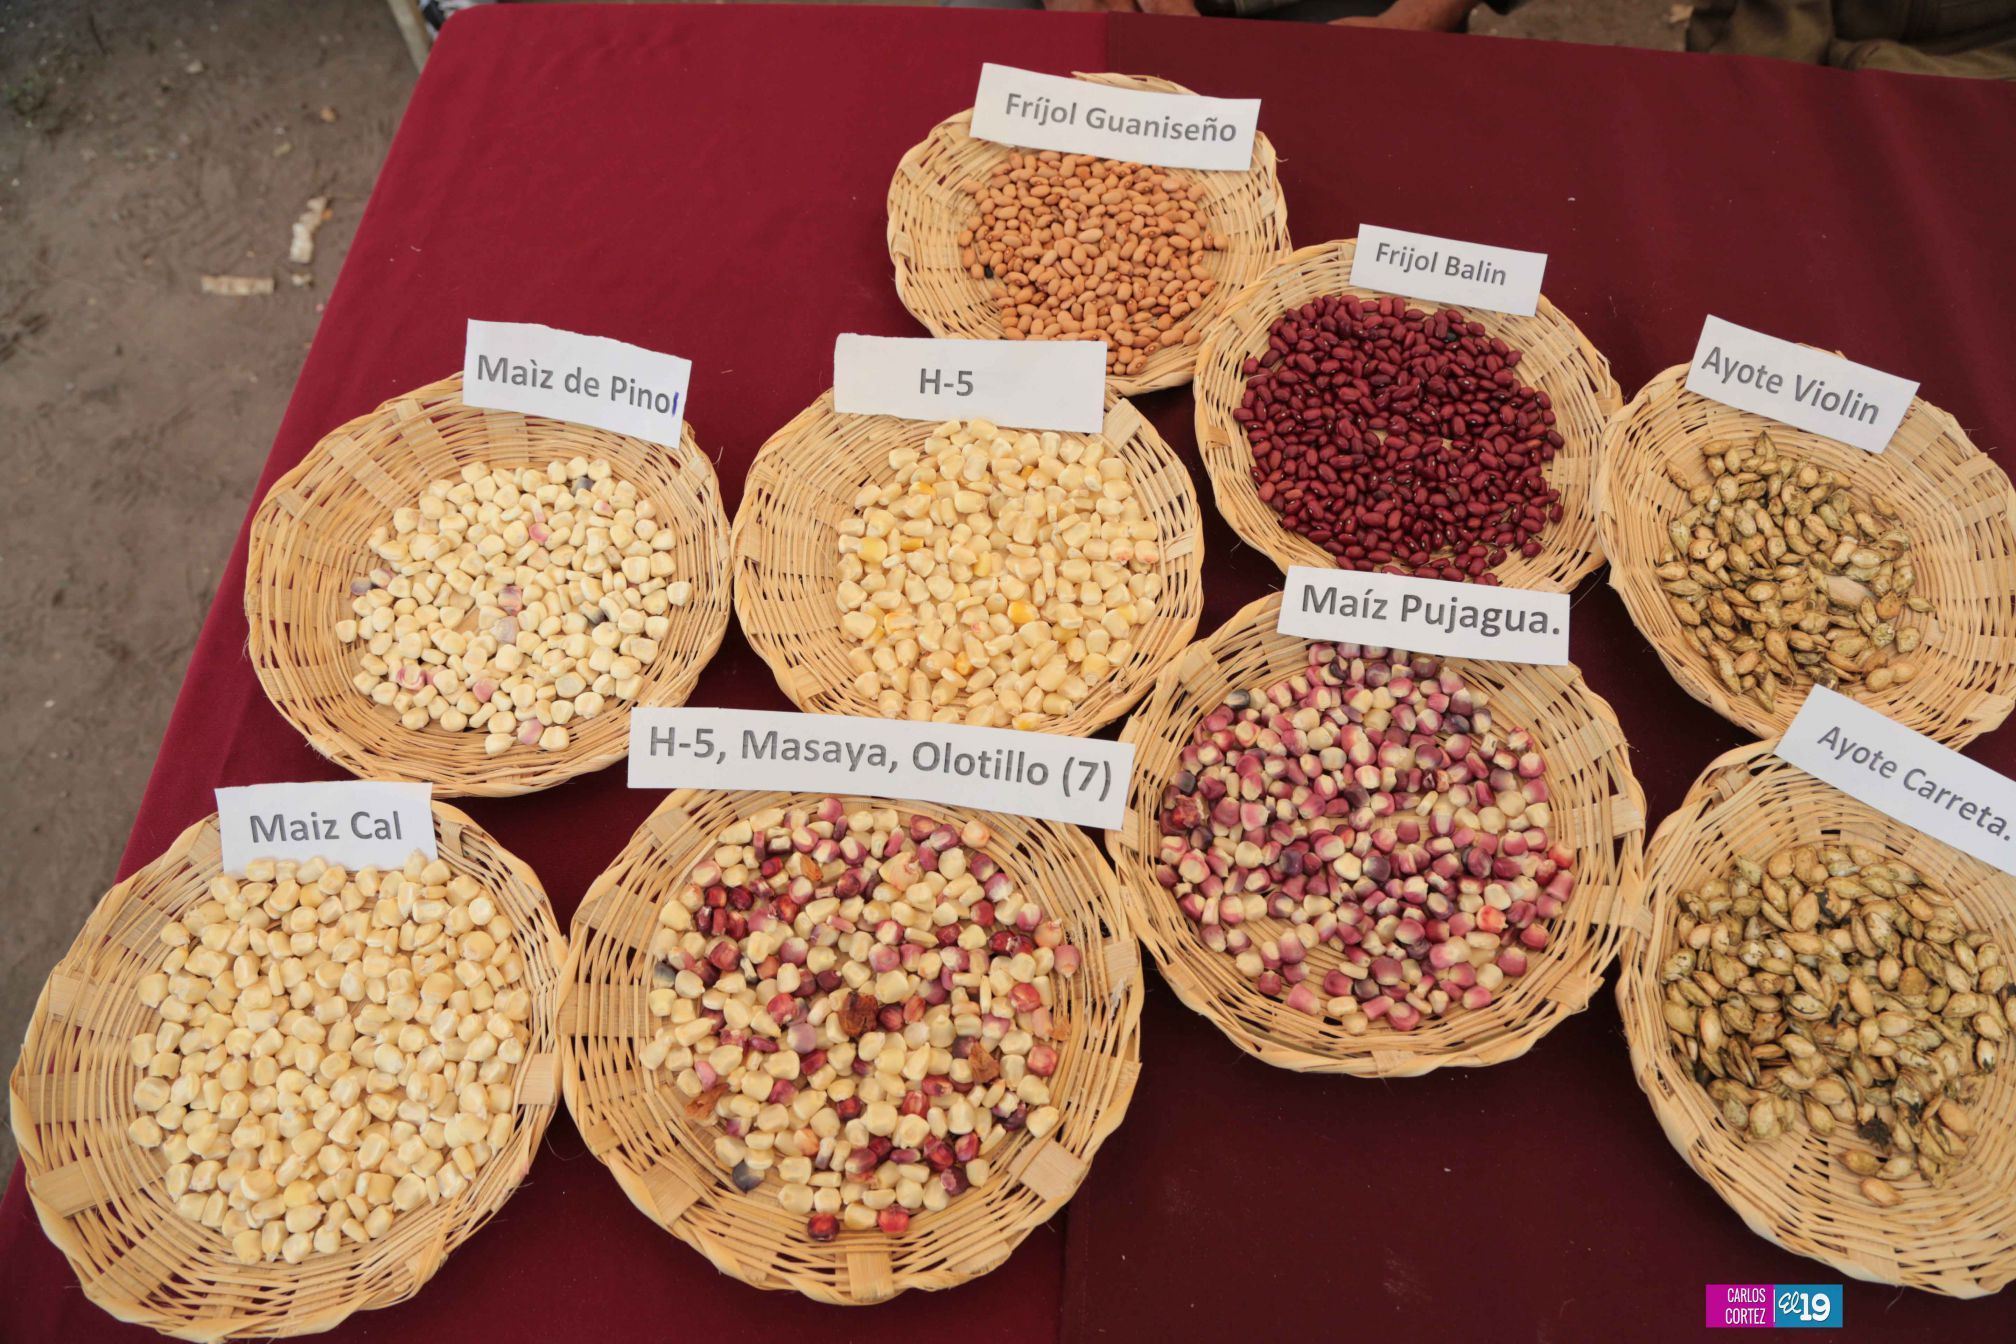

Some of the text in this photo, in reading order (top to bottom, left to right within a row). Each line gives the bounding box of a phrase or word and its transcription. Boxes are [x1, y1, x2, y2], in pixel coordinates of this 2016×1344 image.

[1005, 92, 1237, 142] Fríjol Guaniseño
[1375, 242, 1507, 286] Frijol Balin
[564, 366, 600, 398] de
[610, 375, 680, 418] Pinol
[919, 367, 975, 397] H-5
[1700, 346, 1880, 425] Ayote Violin
[1301, 584, 1561, 637] Maíz Pujagua.
[648, 725, 1113, 802] H-5, Masaya, Olotillo (7)
[1816, 725, 2012, 842] Ayote Carreta.
[249, 810, 402, 843] Maiz Cal
